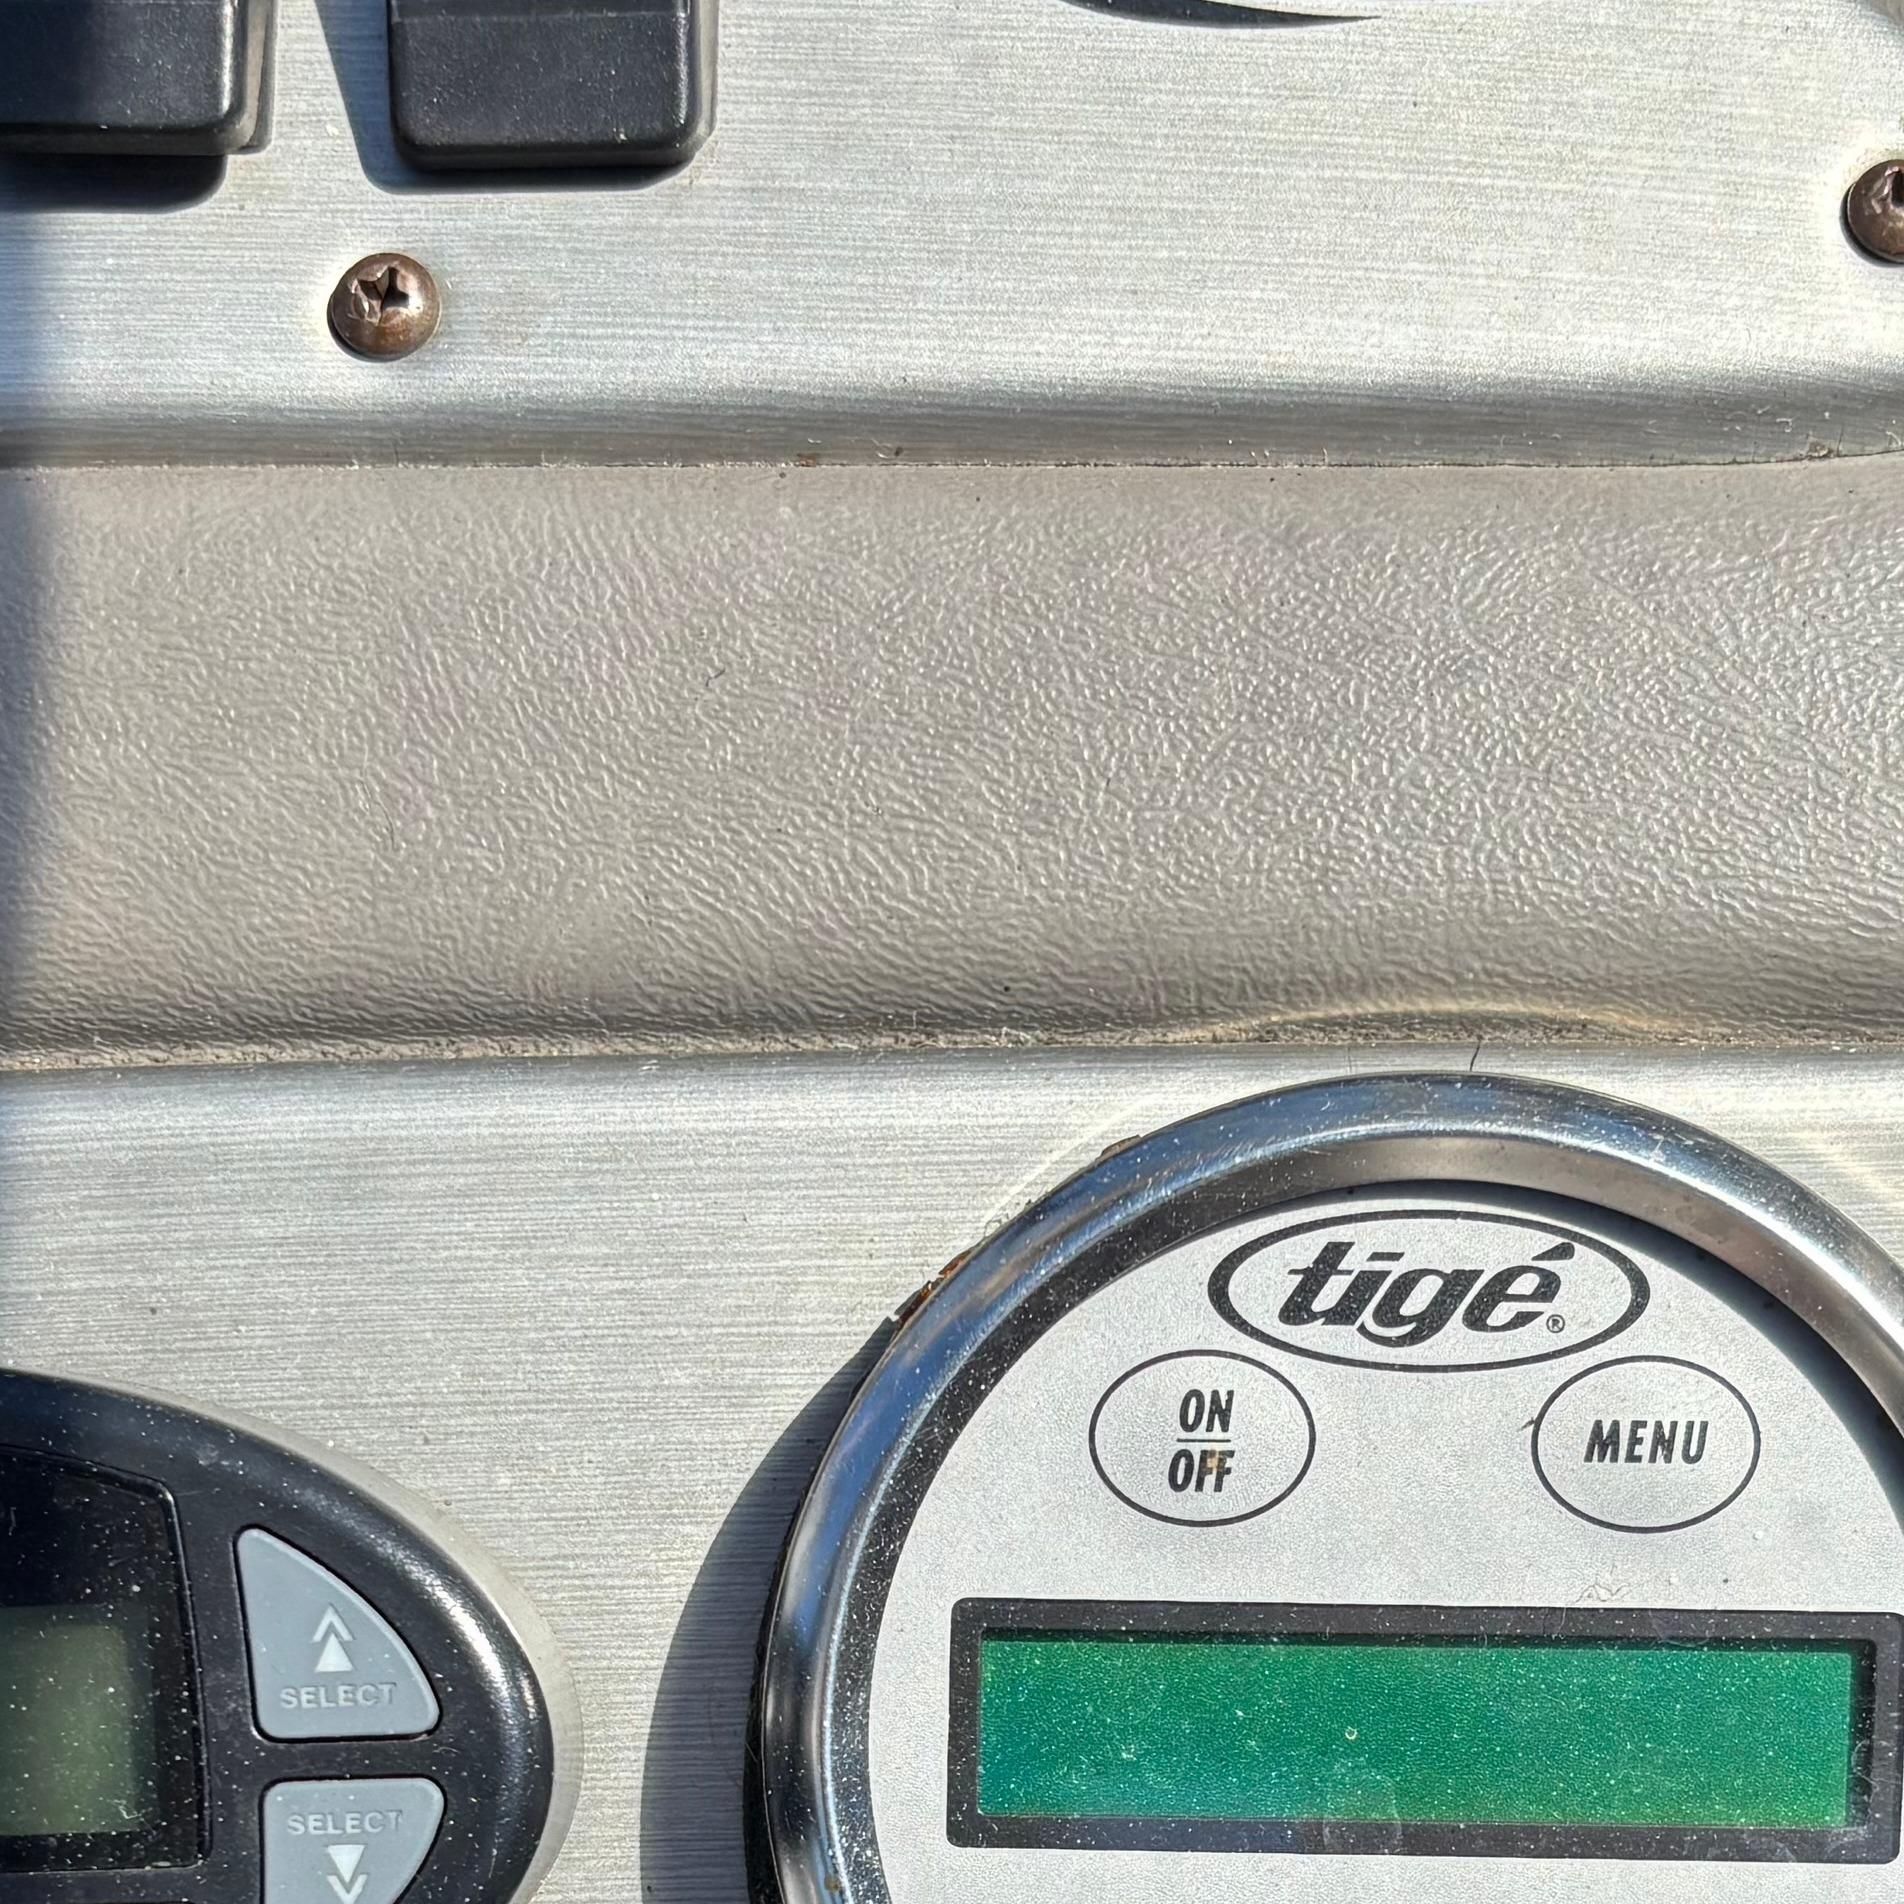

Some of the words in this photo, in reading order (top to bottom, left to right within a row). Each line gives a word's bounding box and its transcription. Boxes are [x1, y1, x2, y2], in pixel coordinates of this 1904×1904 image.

[1179, 1389, 1235, 1434] ON
[1583, 1418, 1710, 1464] MENU
[1167, 1447, 1236, 1494] OFF
[279, 1682, 397, 1709] SELECT
[286, 1809, 403, 1836] SELECT
